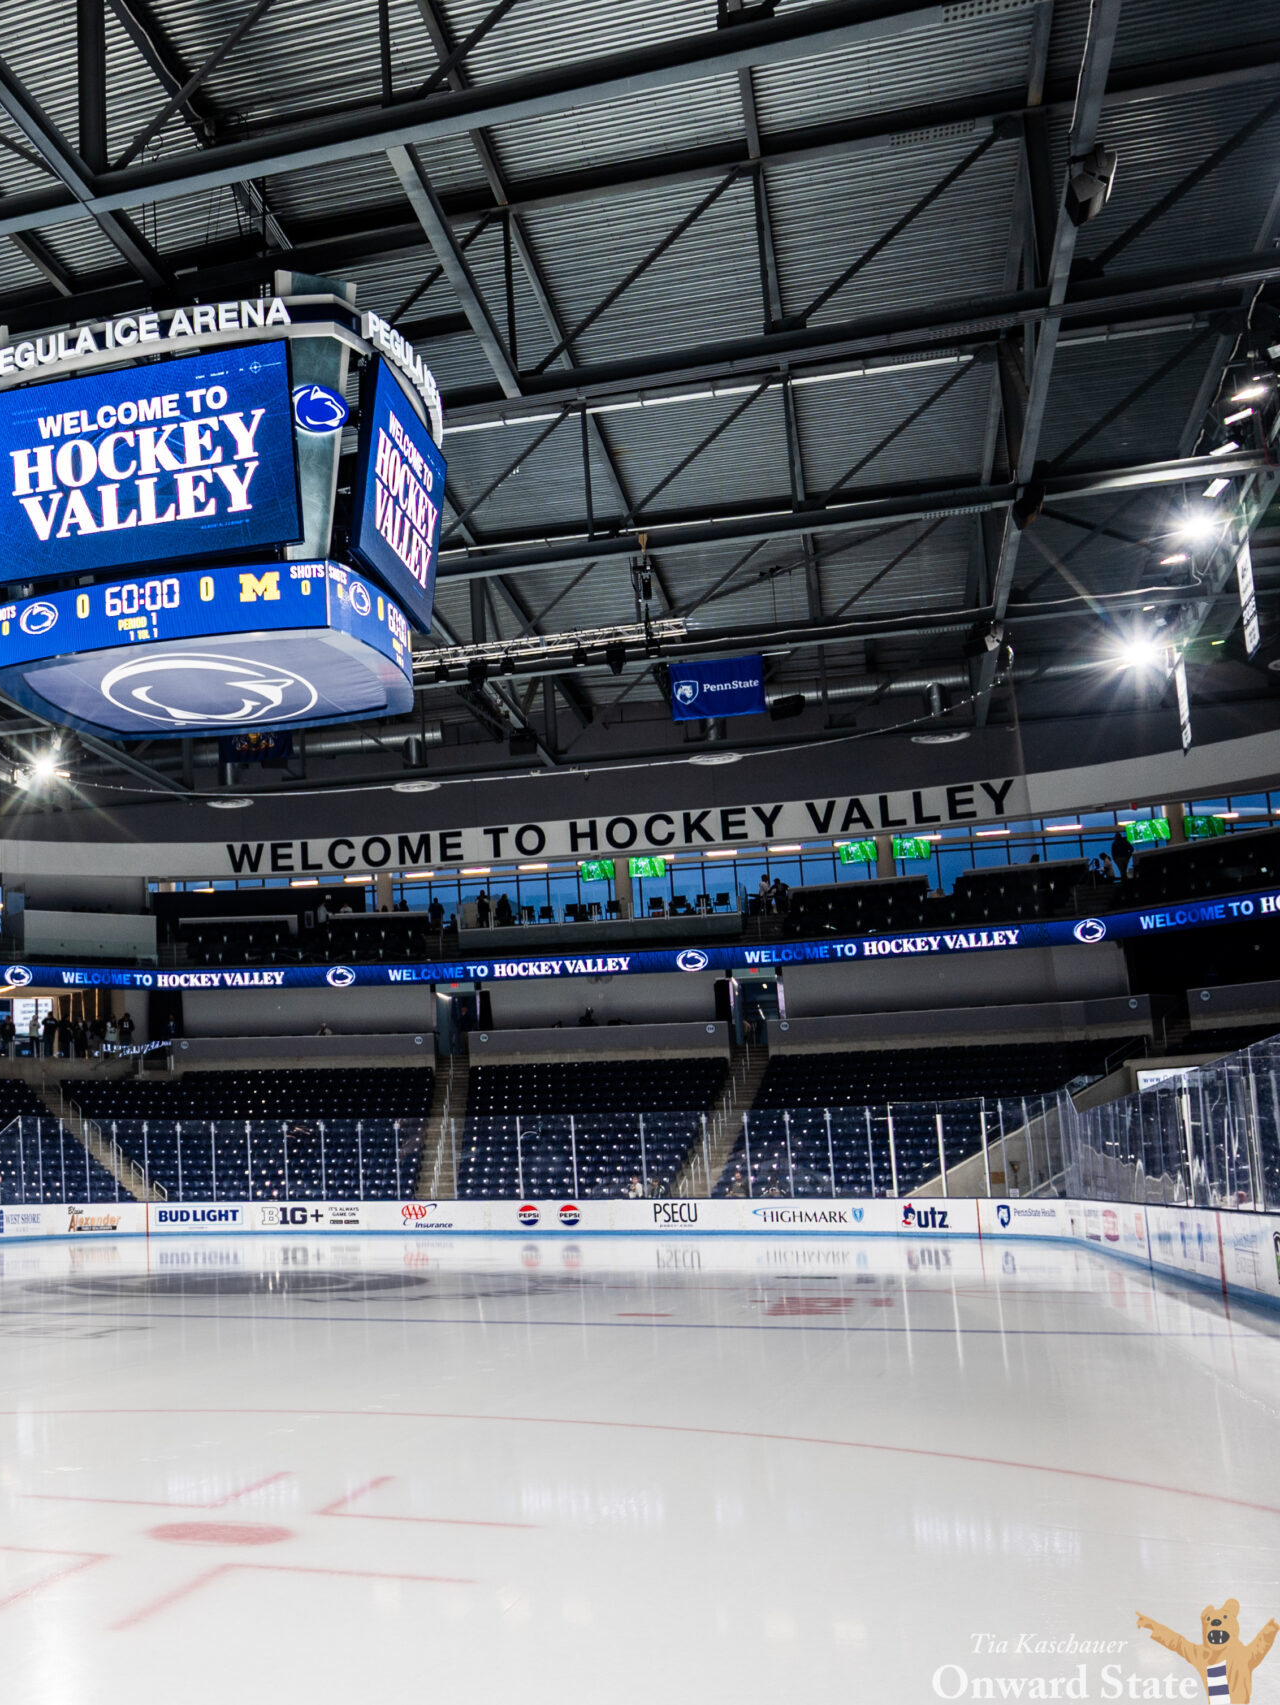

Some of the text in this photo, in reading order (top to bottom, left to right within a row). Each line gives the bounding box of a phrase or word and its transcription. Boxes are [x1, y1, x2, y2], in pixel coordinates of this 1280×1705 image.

[106, 312, 160, 348] ICE
[168, 298, 291, 337] ARENA
[362, 311, 424, 385] PEGULA
[38, 393, 180, 439] WELCOME
[185, 386, 228, 413] TO
[10, 408, 265, 496] HOCKEY
[389, 410, 433, 492] WELCOME TO
[18, 461, 259, 541] VALLEY
[376, 427, 438, 548] HOCKEY
[375, 478, 432, 589] VALLEY
[1, 580, 311, 636] 0 PERIOD 1 0
[76, 594, 90, 619] 0
[105, 578, 180, 617] 60:00
[200, 576, 215, 601] 0
[239, 571, 281, 602] M
[289, 564, 325, 579] SHOTS
[129, 630, 135, 641] 1
[153, 627, 159, 638] 1
[703, 679, 759, 692] PennState
[226, 779, 1014, 873] WELCOME TO HOCKEY VALLEY
[1140, 904, 1225, 930] WELCOME
[1228, 900, 1254, 917] TO
[745, 929, 1019, 964] WELCOME TO HOCKEY VALLEY
[62, 971, 285, 988] WELCOME TO HOCKEY VALLEY
[388, 957, 630, 982] WELCOME TO HOCKEY VALLEY
[68, 1213, 121, 1232] Alexander
[158, 1209, 239, 1223] BUD LIGHT
[403, 1205, 426, 1219] AAA
[653, 1203, 697, 1223] PSECU
[763, 1210, 848, 1224] HIGHMARK
